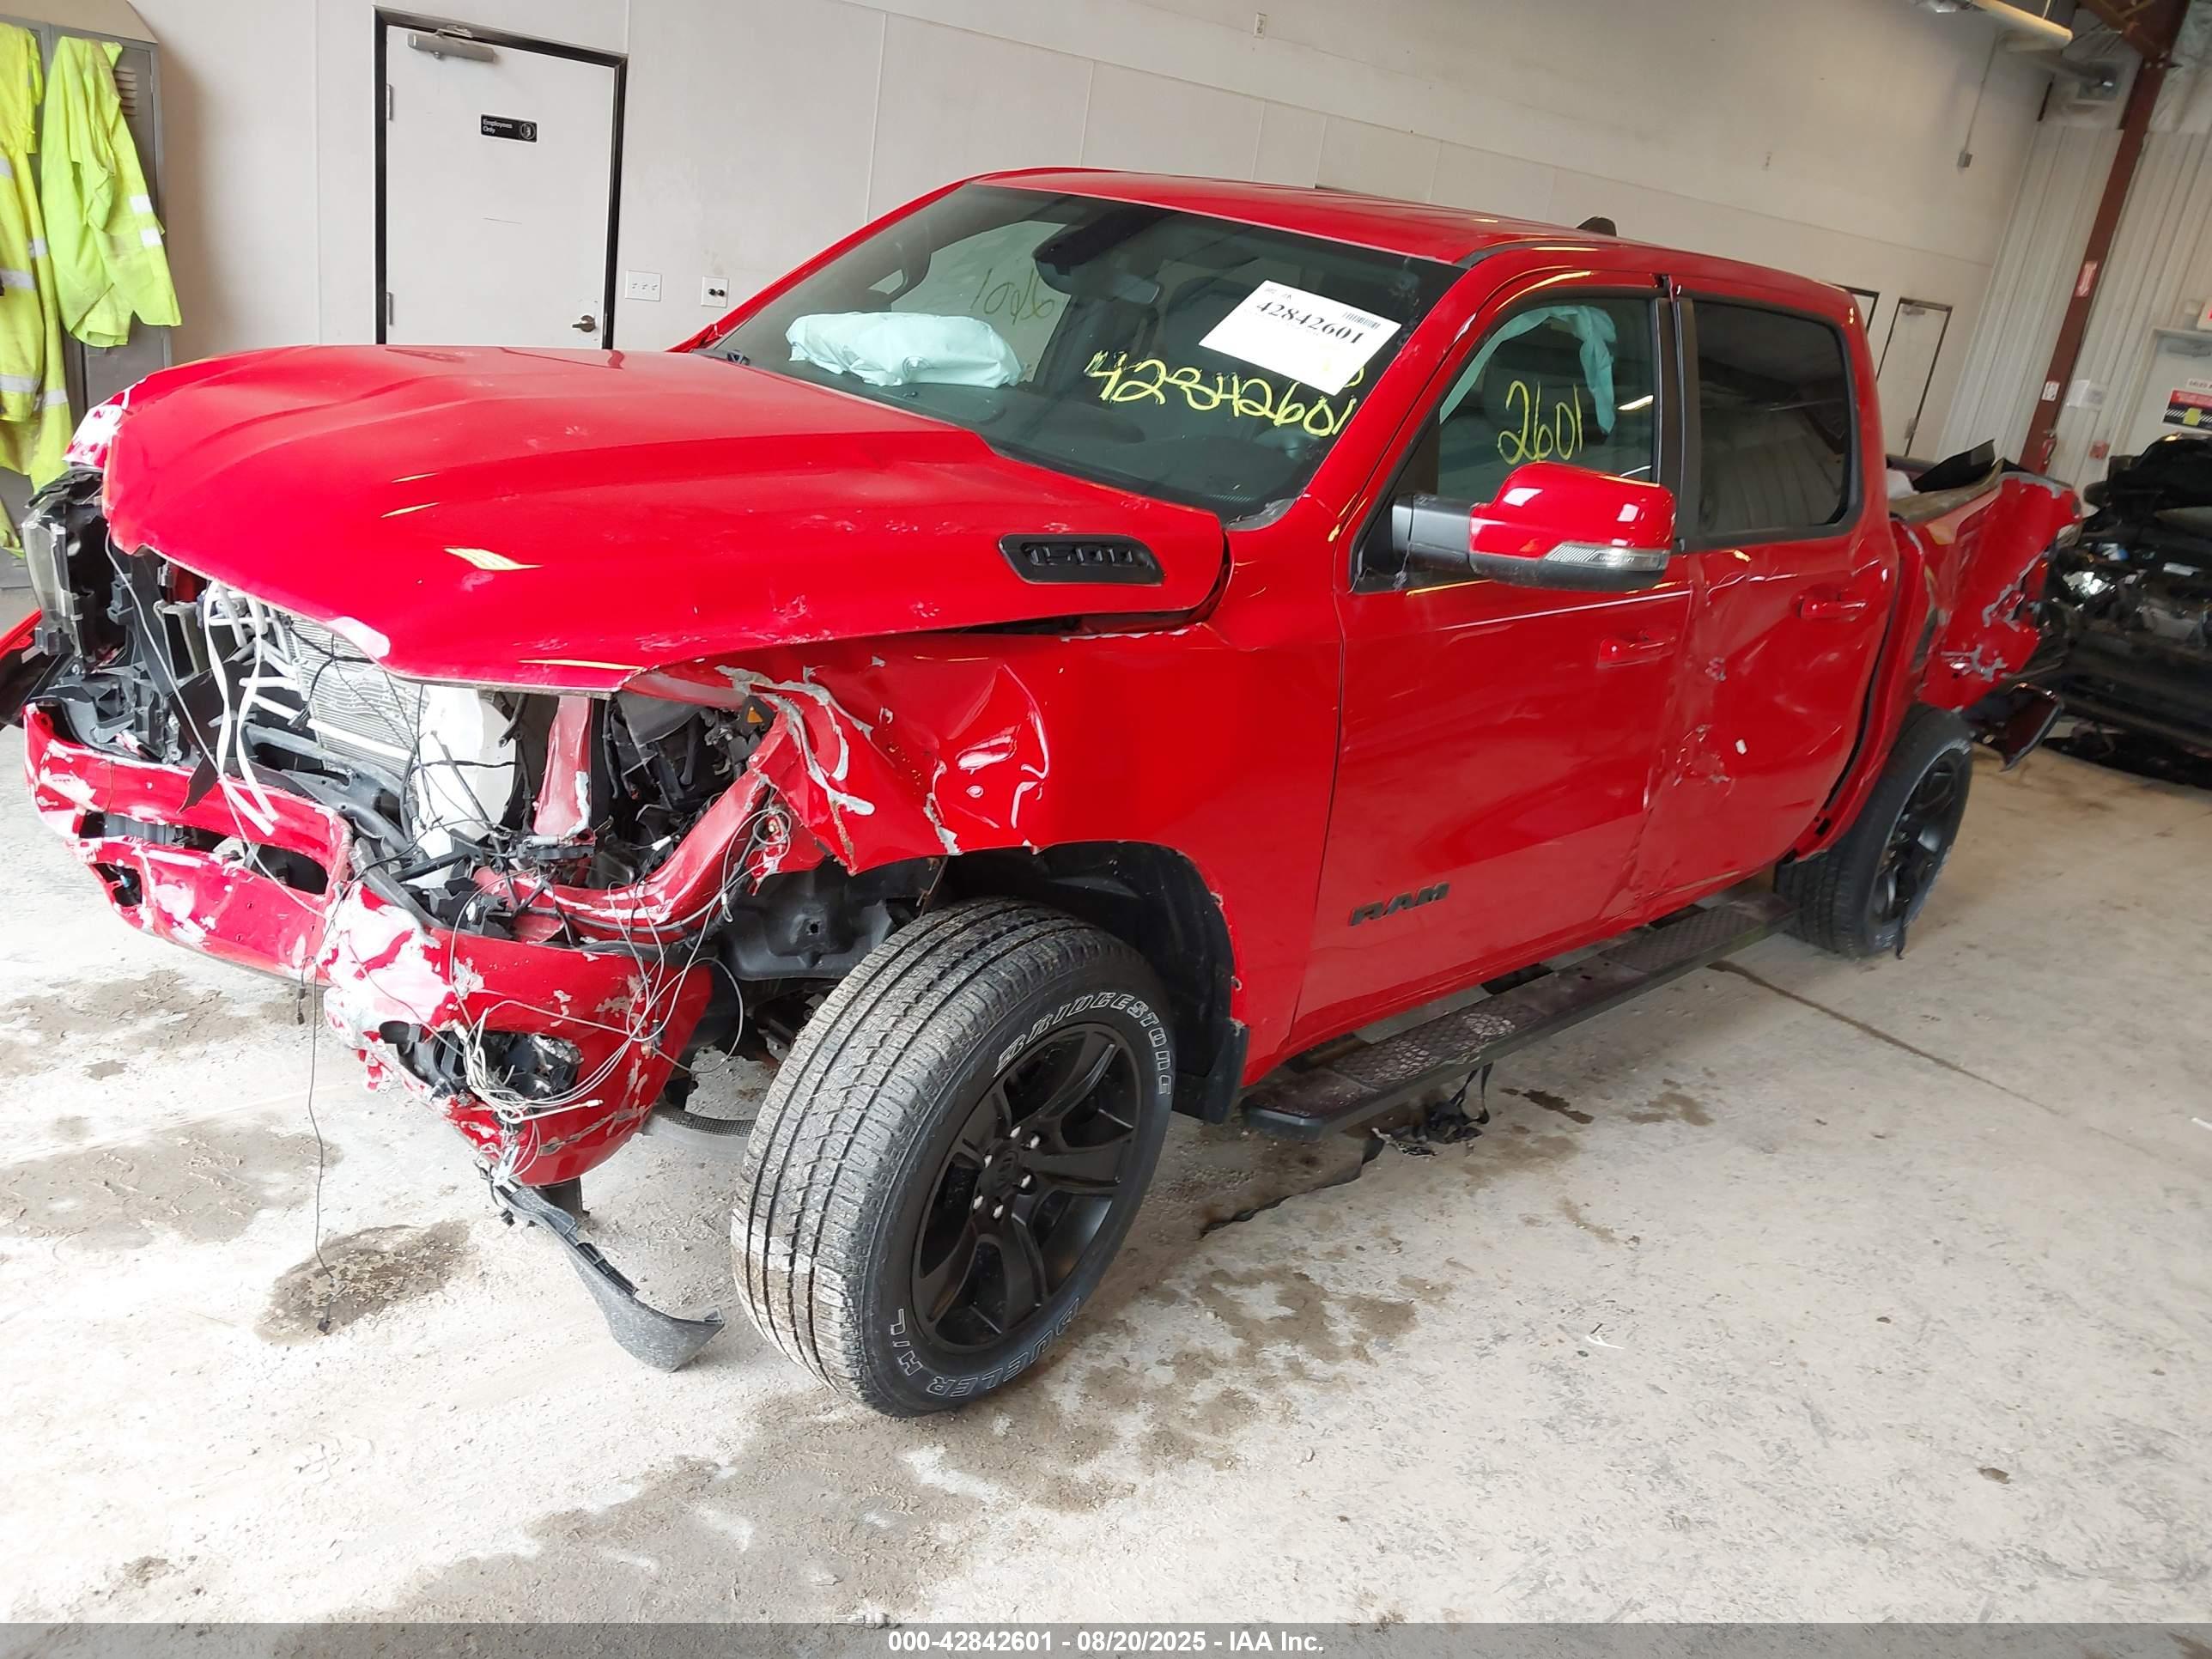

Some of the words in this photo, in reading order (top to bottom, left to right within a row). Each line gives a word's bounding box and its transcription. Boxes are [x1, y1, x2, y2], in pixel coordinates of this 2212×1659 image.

[483, 118, 513, 128] Employees
[1256, 301, 1364, 343] 42842601
[1084, 350, 1357, 437] 42842601
[1497, 380, 1583, 465] 2601
[1022, 542, 1138, 567] 1500
[1349, 882, 1449, 927] RAM
[993, 992, 1172, 1095] BRIDGESTONE
[927, 1297, 1079, 1397] DUELER
